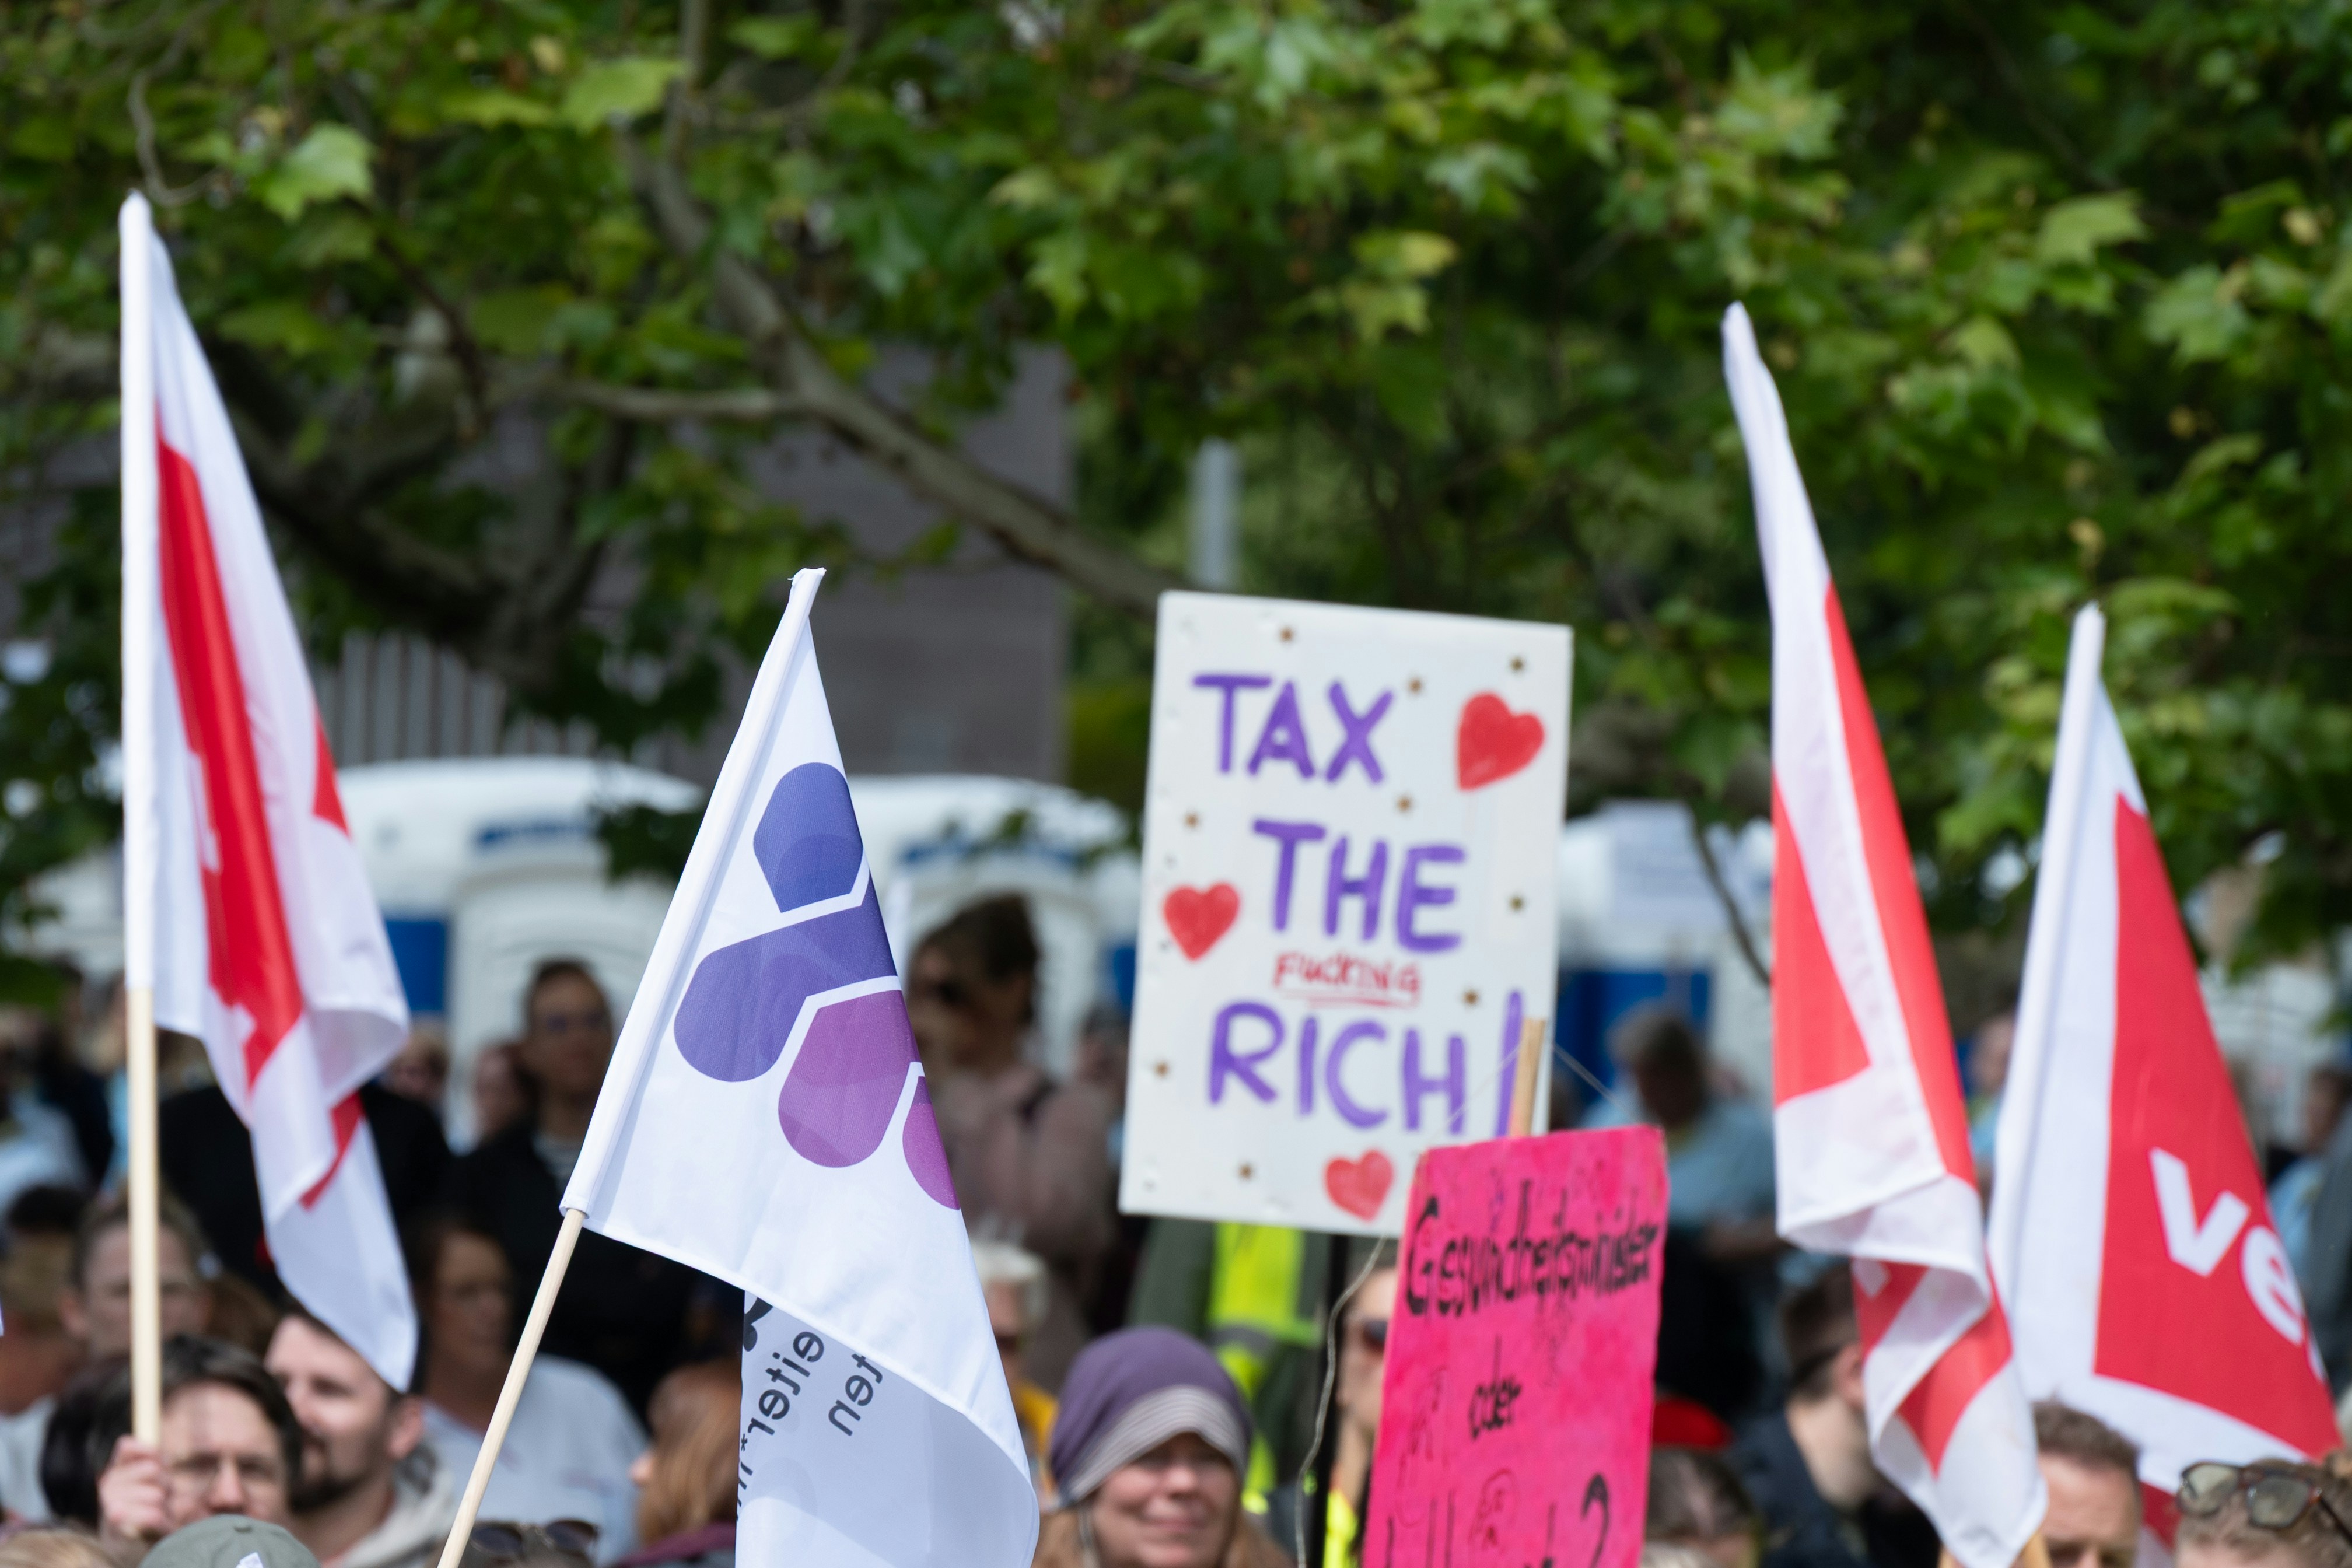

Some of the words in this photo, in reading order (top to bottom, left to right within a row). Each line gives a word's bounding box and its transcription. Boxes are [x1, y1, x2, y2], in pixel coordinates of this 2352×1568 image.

[1192, 674, 1395, 785] TAX
[1252, 818, 1466, 953] THE
[1209, 989, 1525, 1136] RICH!
[2148, 1145, 2325, 1385] ve
